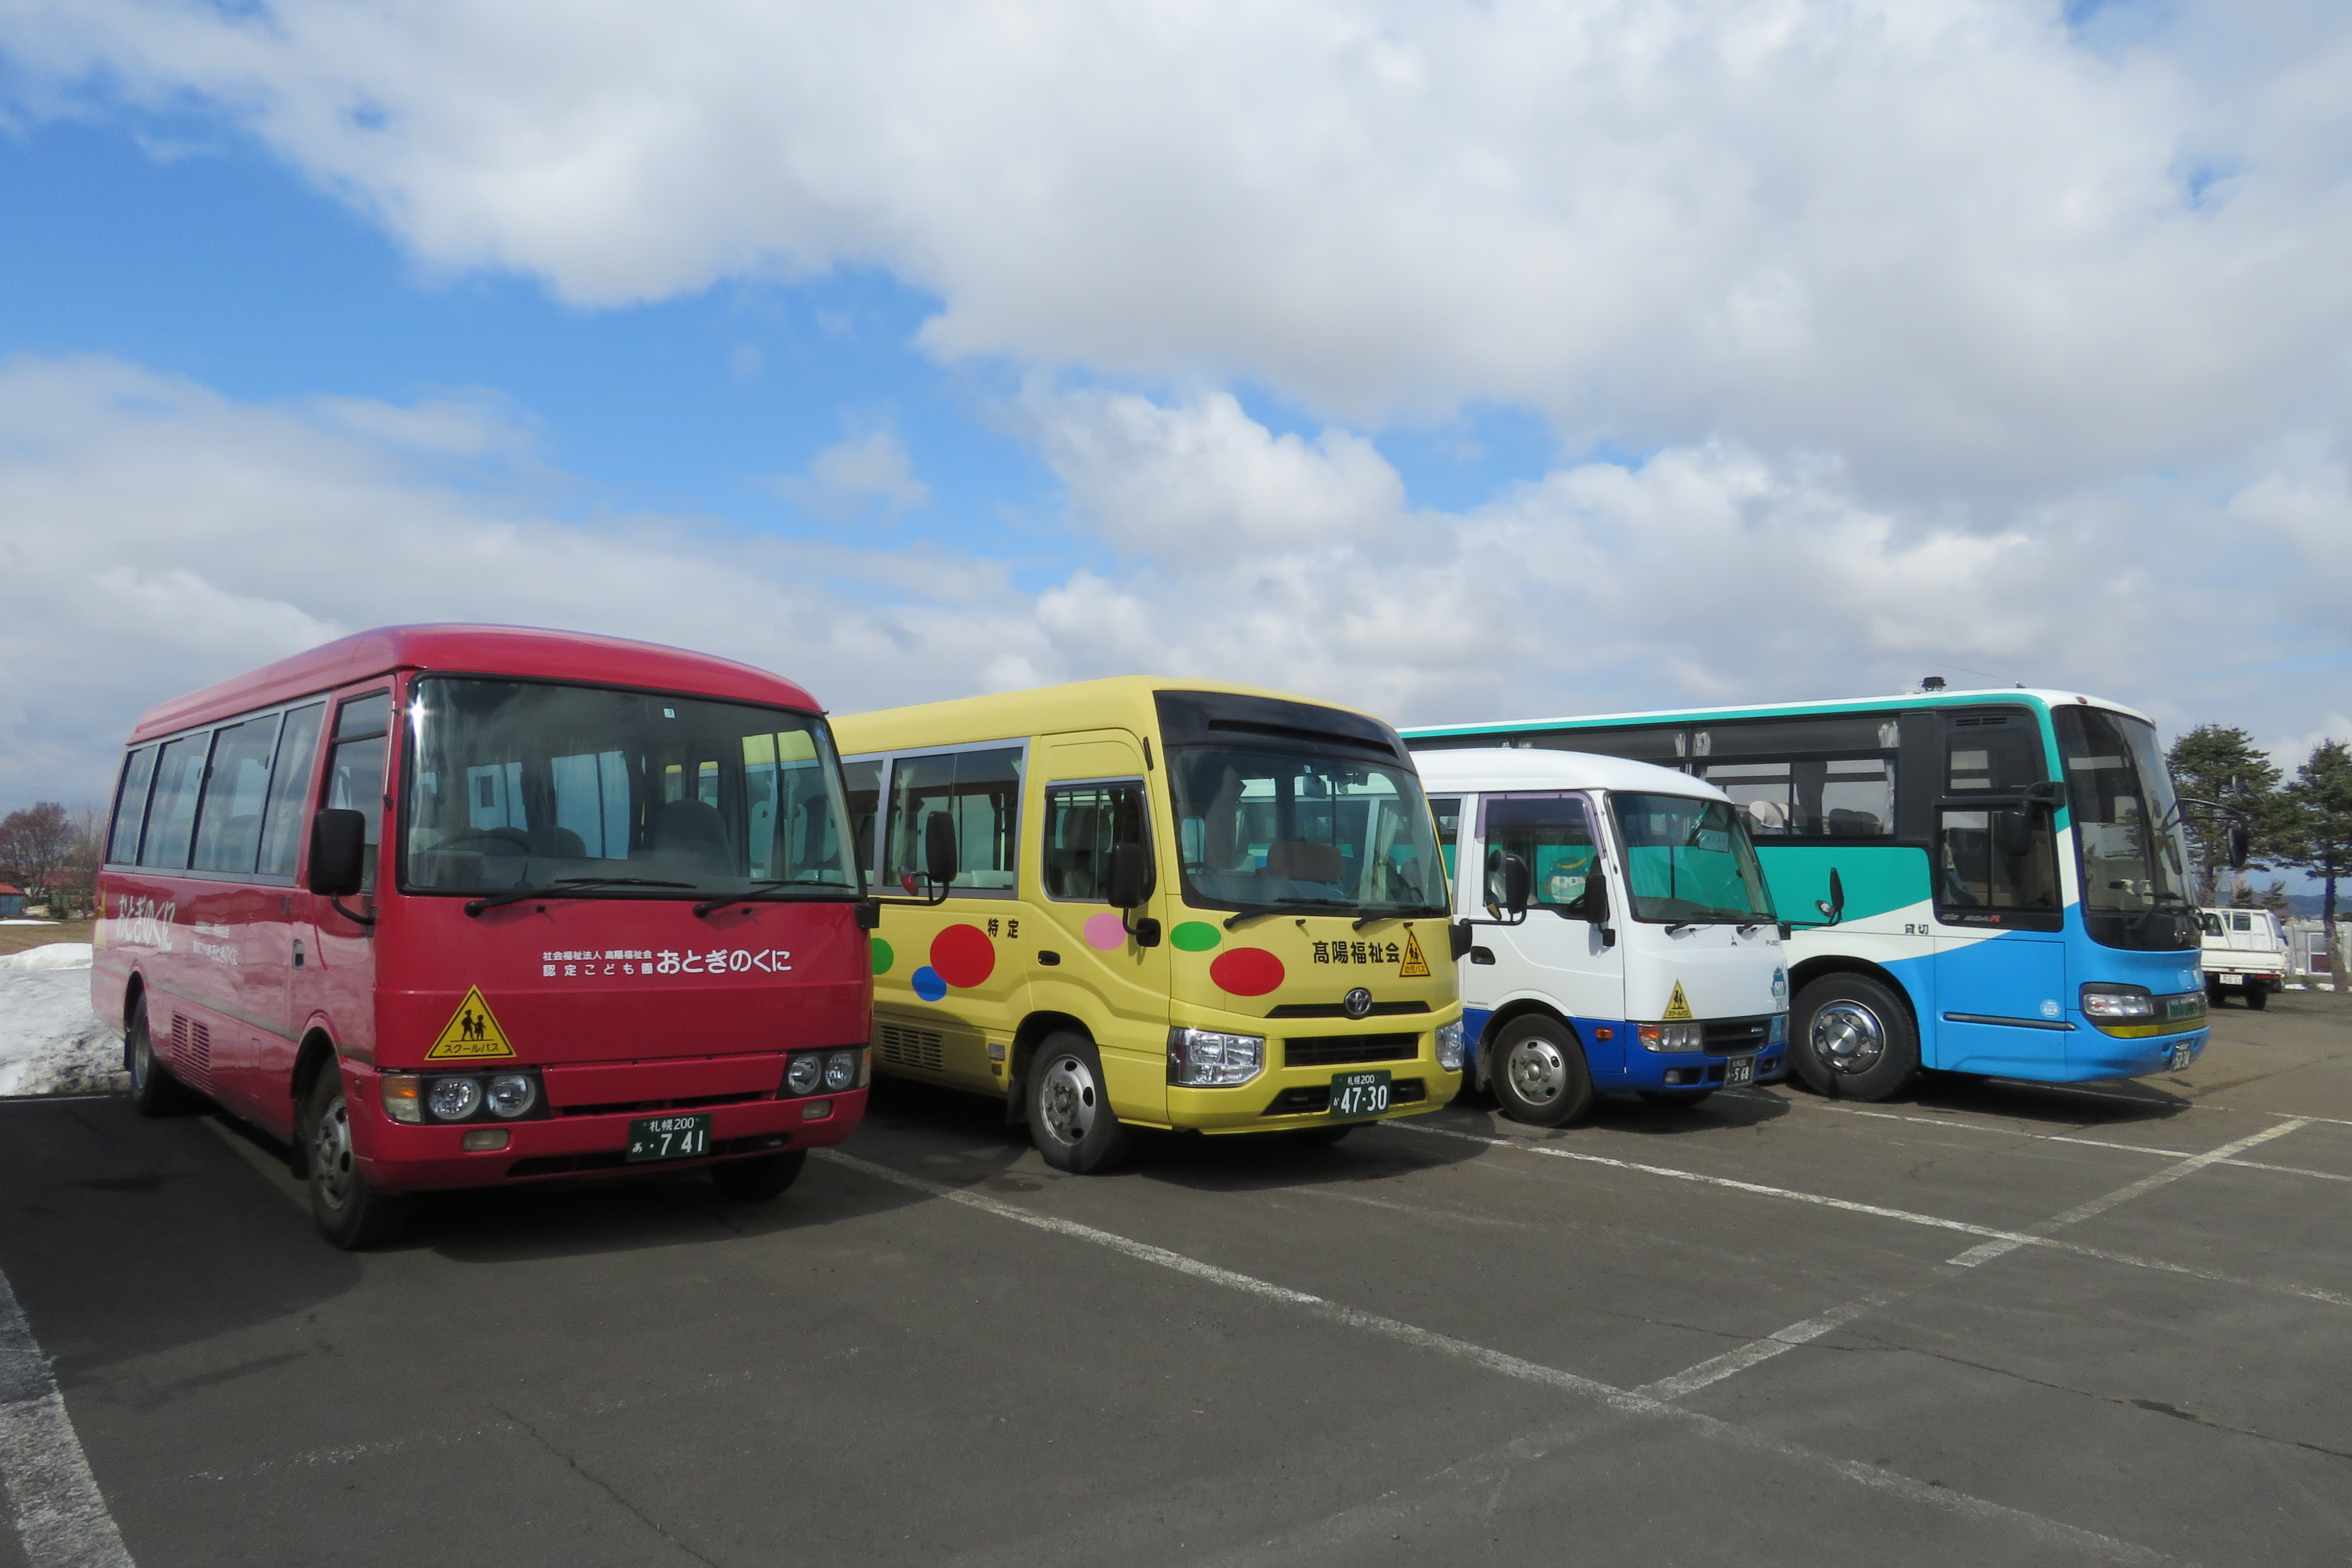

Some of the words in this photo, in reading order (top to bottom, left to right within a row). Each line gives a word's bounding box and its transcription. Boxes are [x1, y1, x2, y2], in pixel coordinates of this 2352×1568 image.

[988, 918, 1019, 938] 特定
[1905, 923, 1929, 935] 貸切
[543, 950, 602, 961] 社会福祉法人
[656, 948, 792, 974] おとぎのくに
[543, 962, 654, 977] 認定こども園
[443, 1043, 500, 1054] スクールバス
[1340, 1085, 1388, 1114] 47-30
[649, 1117, 695, 1132] 札幌200
[632, 1141, 643, 1153] あ
